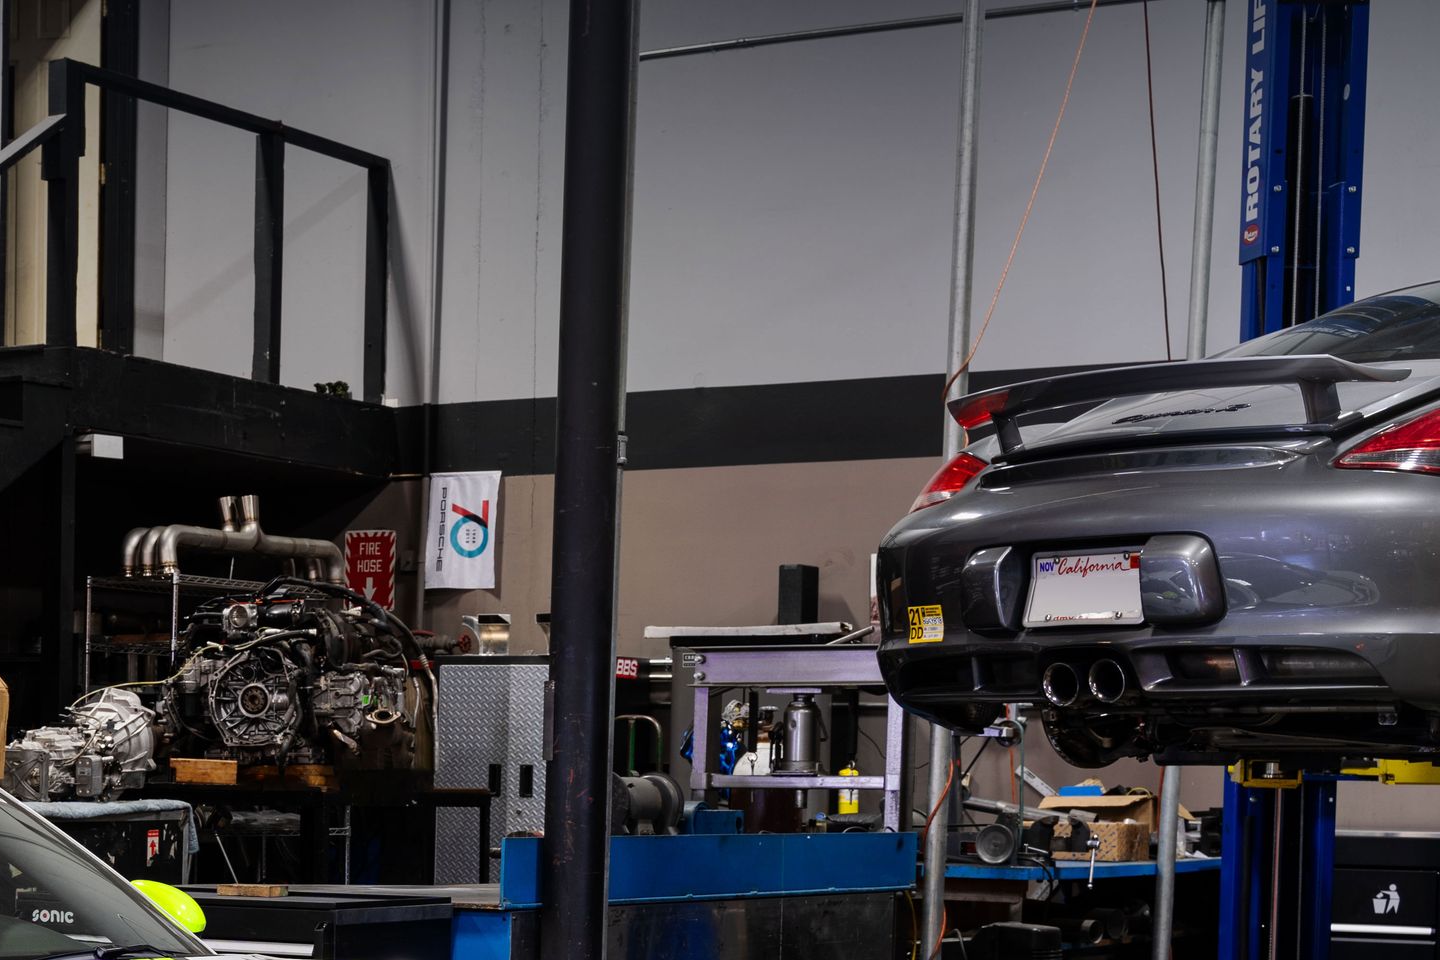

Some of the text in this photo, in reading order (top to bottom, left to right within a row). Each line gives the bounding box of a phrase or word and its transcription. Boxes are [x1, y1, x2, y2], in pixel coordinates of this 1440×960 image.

[1246, 68, 1263, 222] ROTARY
[436, 487, 447, 572] PORSCHE
[359, 542, 381, 555] FIRE
[357, 560, 382, 573] HOSE
[1040, 557, 1132, 578] NOV California
[910, 608, 921, 626] 21
[911, 627, 924, 640] DD
[616, 659, 639, 676] BBS
